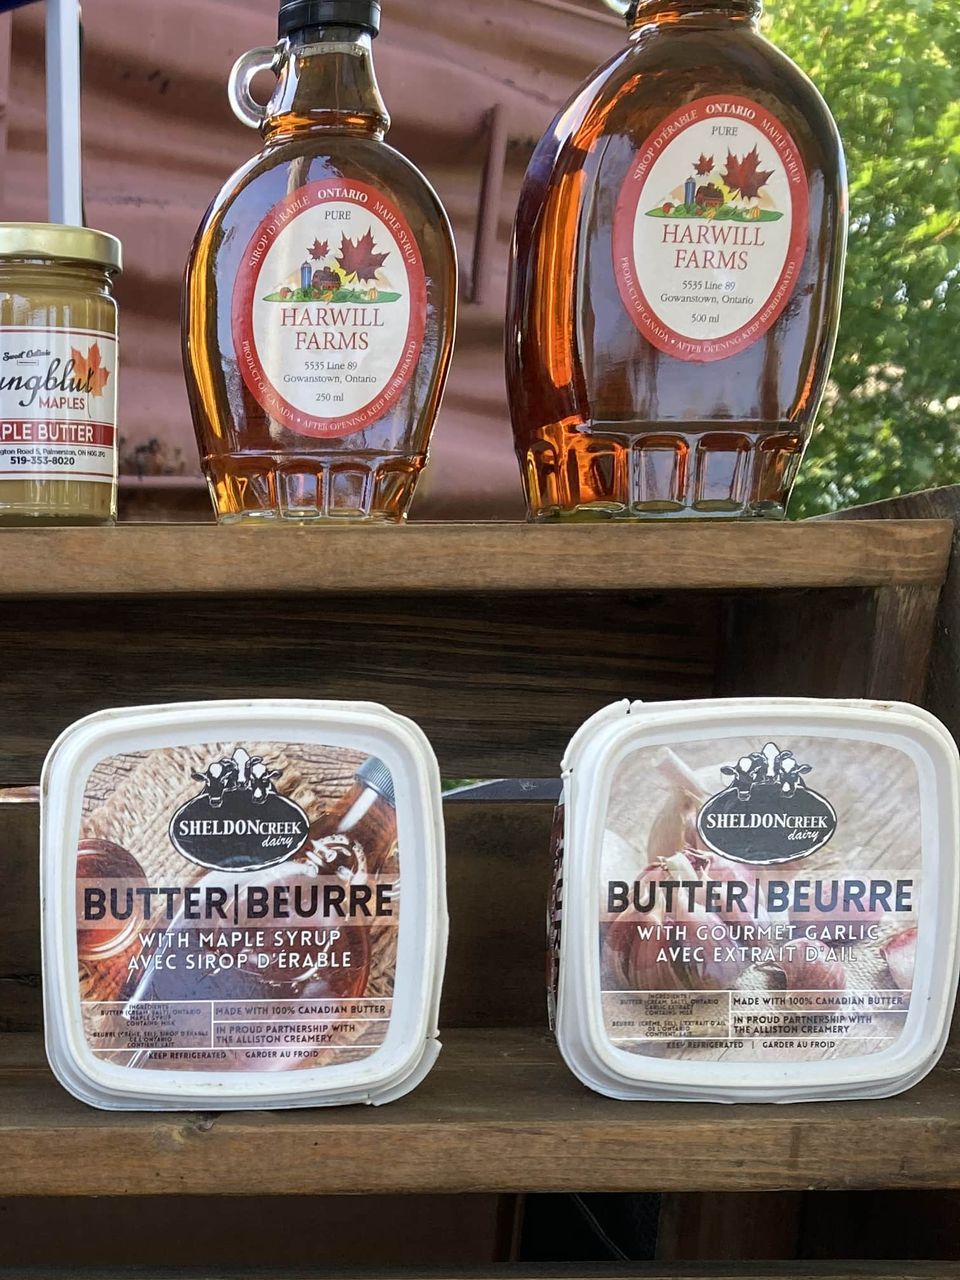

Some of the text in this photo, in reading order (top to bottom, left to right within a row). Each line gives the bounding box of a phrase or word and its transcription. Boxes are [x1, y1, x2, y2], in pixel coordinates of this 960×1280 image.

[711, 126, 738, 136] PURE
[634, 103, 801, 184] SIROP ONTARIO MAPLE SYRUP
[324, 210, 351, 220] PURE
[317, 188, 417, 265] ONTARIO MAPLE SYRUP
[661, 224, 765, 246] HARWILL
[674, 250, 748, 270] FARMS
[682, 280, 736, 290] 5535 Line 89
[660, 293, 753, 304] Gowanstown, Ontario
[281, 308, 384, 327] HARWILL
[691, 314, 720, 323] 500 ml
[295, 332, 369, 350] FARMS
[304, 361, 357, 370] 5535 Line 89
[284, 374, 377, 384] Gowanstown, Ontario
[38, 397, 85, 410] MAPLES
[316, 393, 344, 402] 250 ml
[38, 424, 93, 441] BUTTER
[10, 456, 75, 465] 519-353-8020
[787, 828, 819, 841] dairy
[262, 835, 293, 848] dairy
[139, 931, 340, 948] WITH MAPLE SYRUP
[637, 925, 878, 941] WITH GOURMET GARLIC
[128, 948, 351, 970] AVEC SIROP D'ÉRABLE
[656, 947, 857, 962] AVEC EXTRAIT D'AIL
[733, 996, 903, 1005] MADE WITH 100% CANADIAN BUTTER
